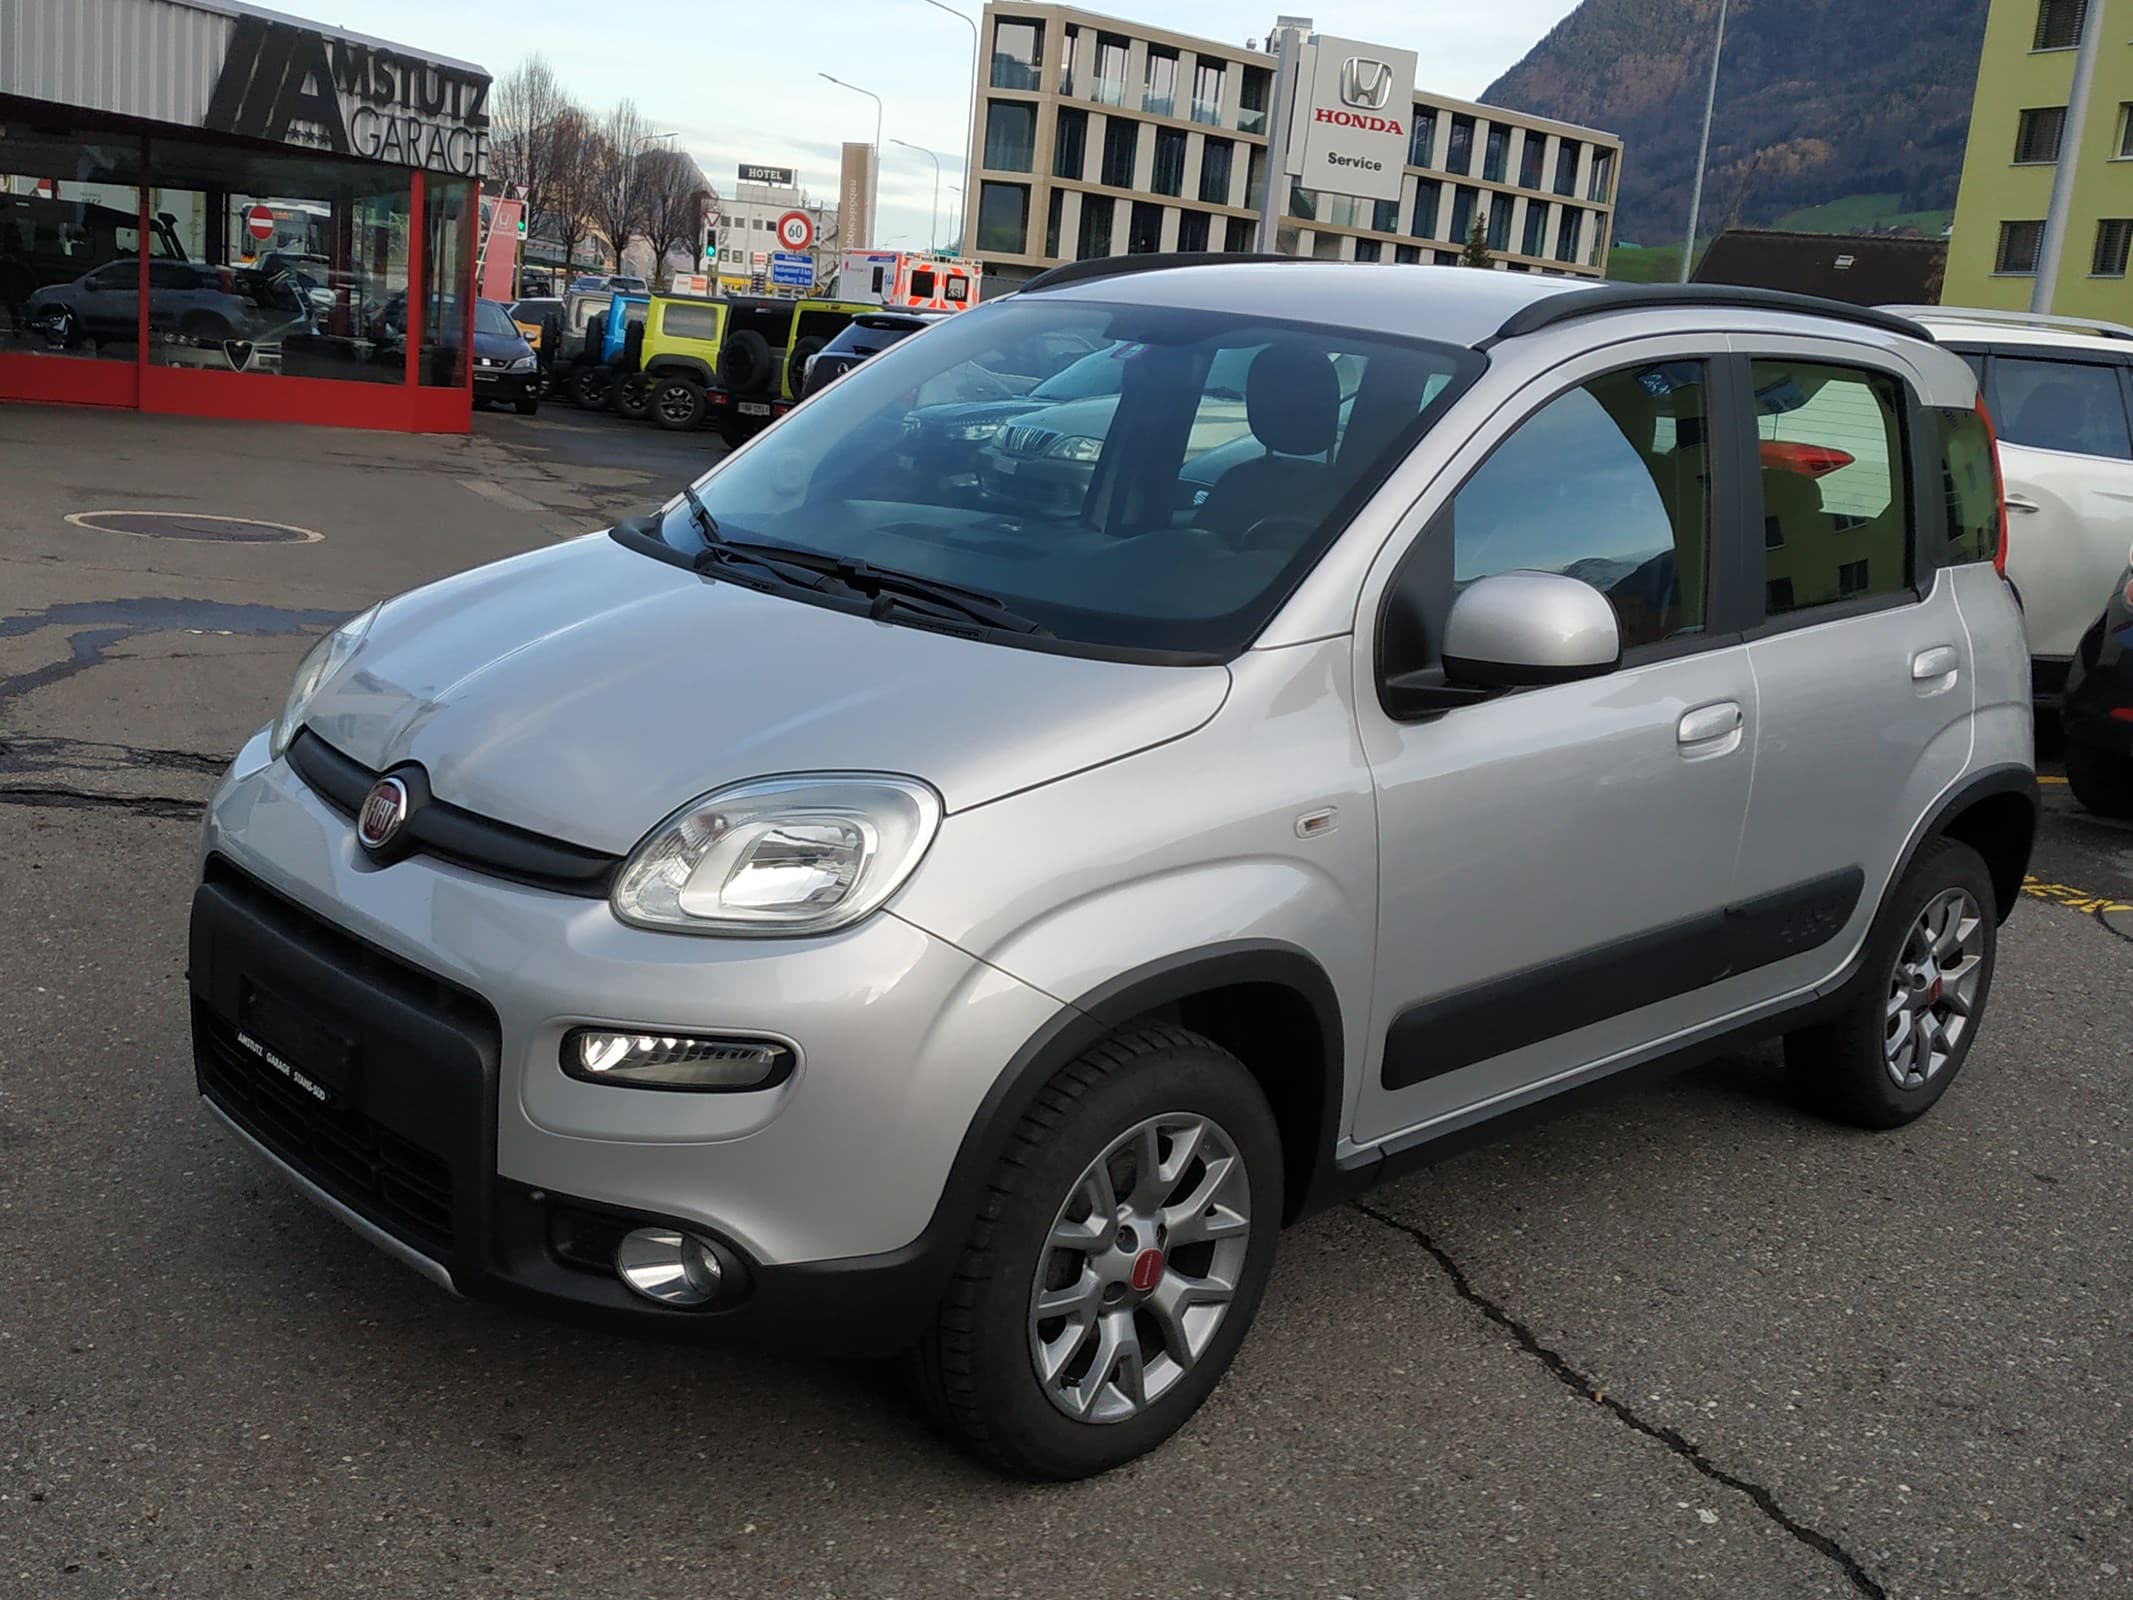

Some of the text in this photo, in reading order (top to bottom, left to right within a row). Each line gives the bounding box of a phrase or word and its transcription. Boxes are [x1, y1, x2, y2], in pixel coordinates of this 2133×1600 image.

[262, 30, 493, 154] AMSTUTZ
[1314, 108, 1404, 135] HONDA
[351, 105, 488, 179] GARAGE
[748, 167, 783, 180] HOTEL
[1327, 152, 1382, 171] Service
[788, 224, 803, 238] 60
[366, 796, 398, 831] FIAT
[266, 1051, 290, 1076] GARAGE
